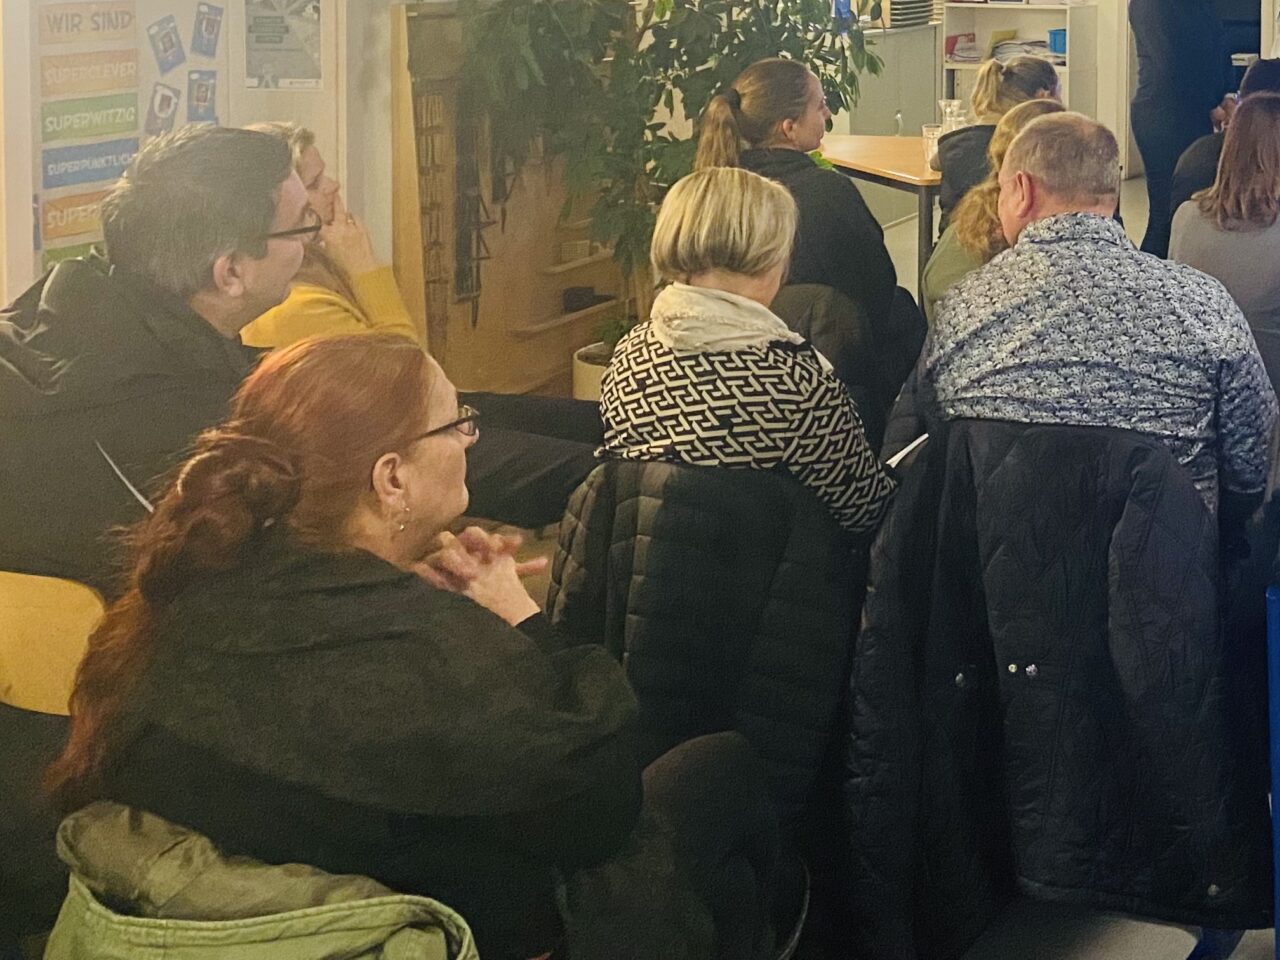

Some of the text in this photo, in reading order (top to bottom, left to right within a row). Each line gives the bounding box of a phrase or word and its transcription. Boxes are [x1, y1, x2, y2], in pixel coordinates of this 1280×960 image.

[46, 10, 133, 33] WIR SIND
[45, 107, 135, 132] SUPERWITZIG
